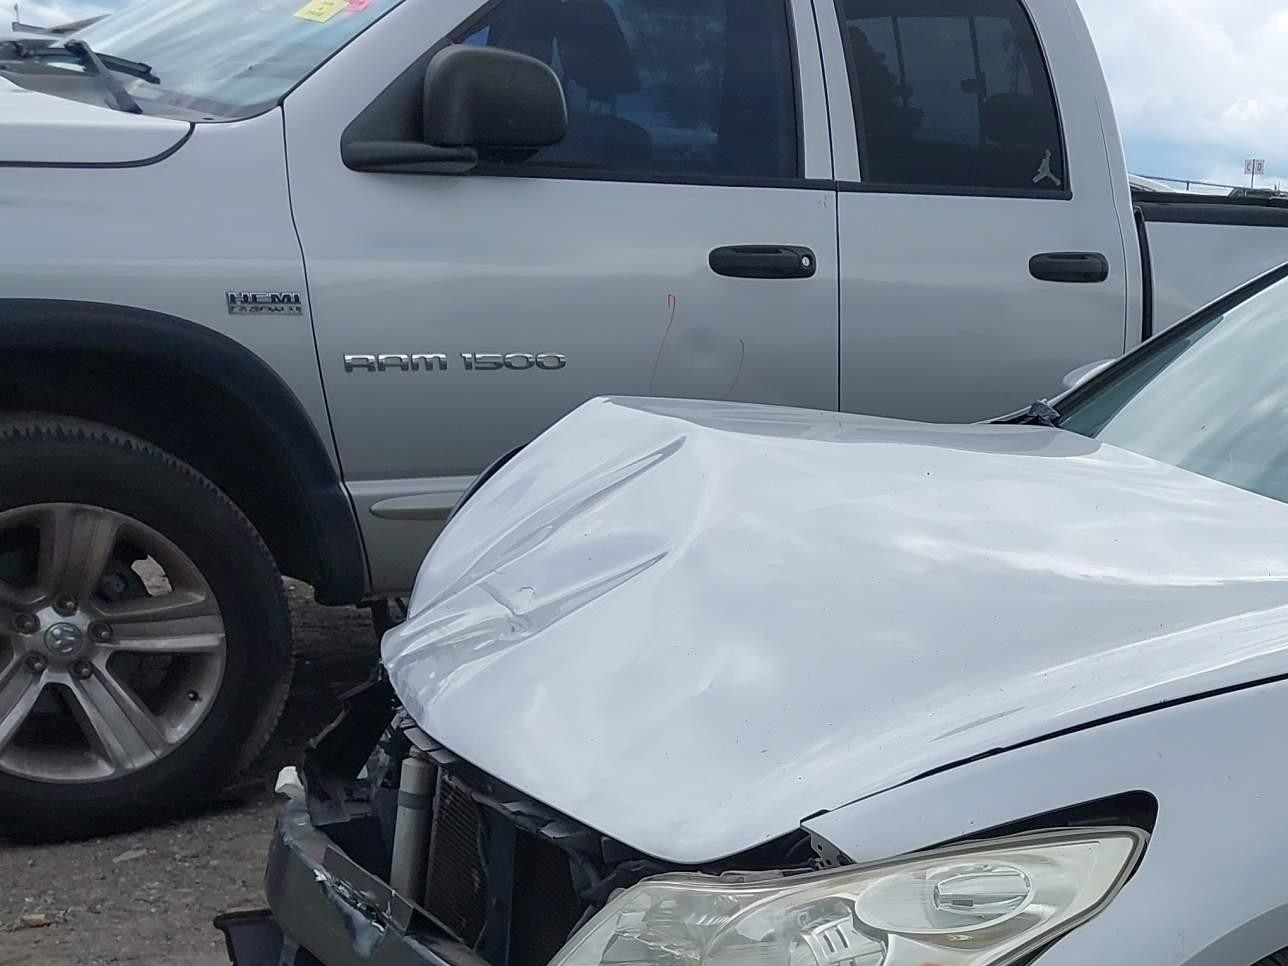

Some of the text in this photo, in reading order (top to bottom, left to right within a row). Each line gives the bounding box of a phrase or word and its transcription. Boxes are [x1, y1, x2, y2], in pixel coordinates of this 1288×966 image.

[226, 291, 301, 305] HEMI
[343, 352, 567, 372] RAM 1500
